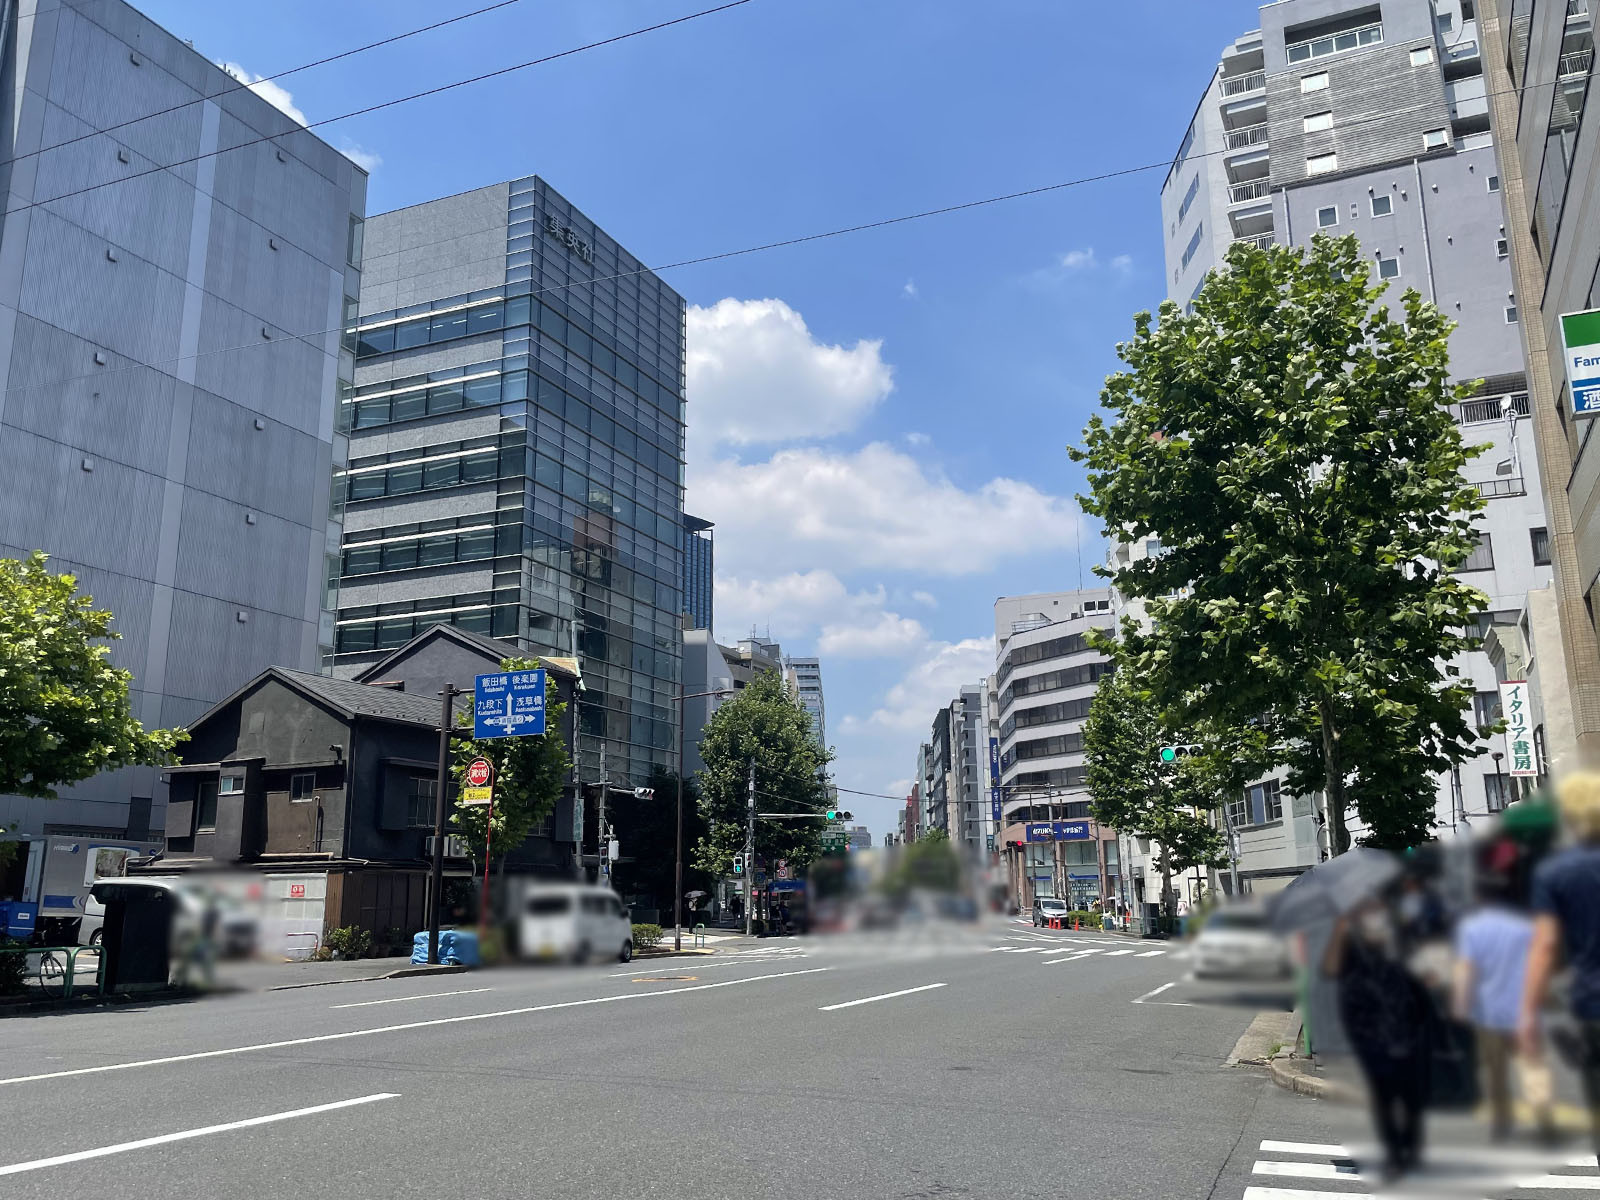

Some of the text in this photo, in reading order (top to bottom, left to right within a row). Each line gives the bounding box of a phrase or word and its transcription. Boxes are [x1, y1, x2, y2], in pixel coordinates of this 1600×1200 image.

[550, 215, 593, 262] 集英社
[482, 673, 538, 687] 飯田橋 後楽園
[477, 695, 542, 710] 九段下 浅草橋
[1507, 685, 1531, 770] イタリア書房
[471, 768, 487, 778] 消火栓
